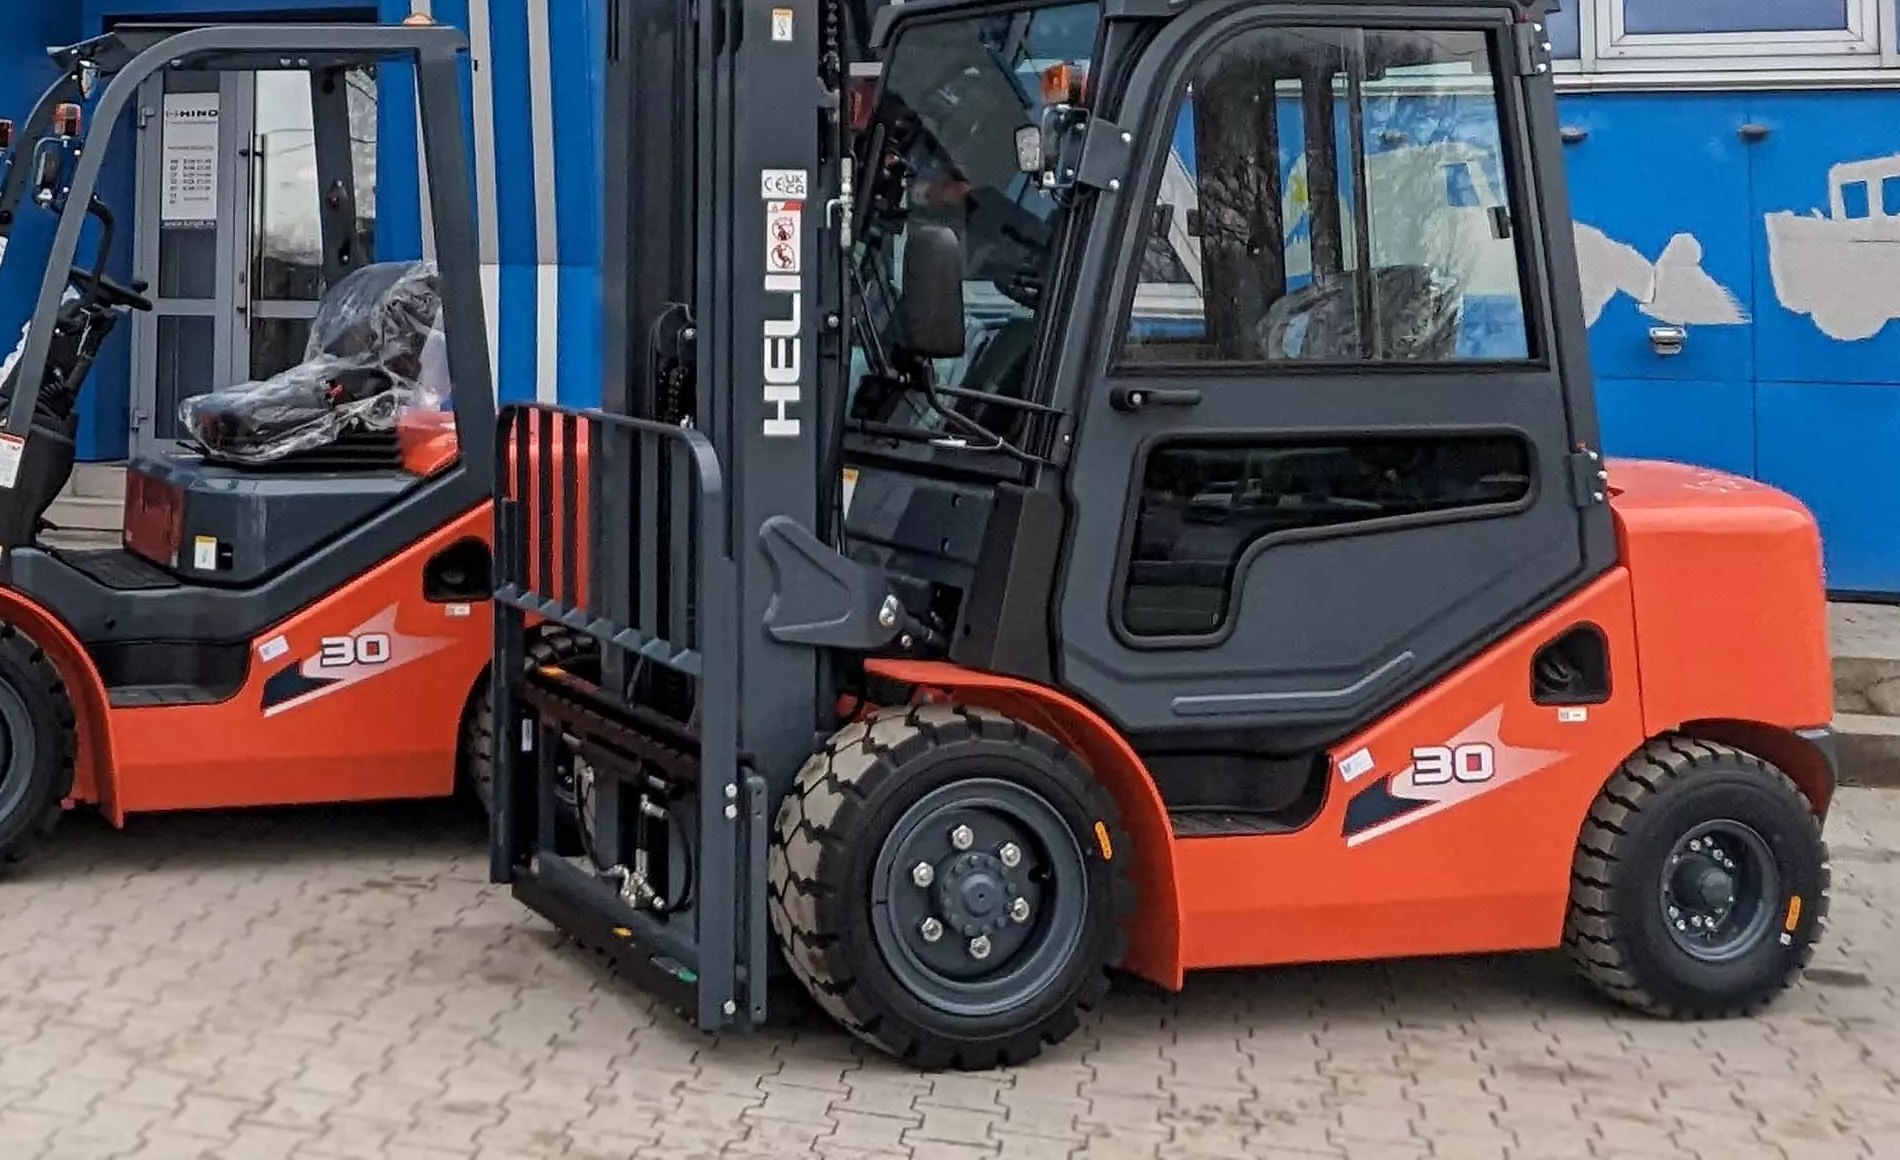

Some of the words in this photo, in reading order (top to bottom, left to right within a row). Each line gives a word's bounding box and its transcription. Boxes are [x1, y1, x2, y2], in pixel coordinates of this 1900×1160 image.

[763, 274, 801, 436] HELI
[320, 633, 391, 667] 30
[1412, 742, 1495, 786] 30
